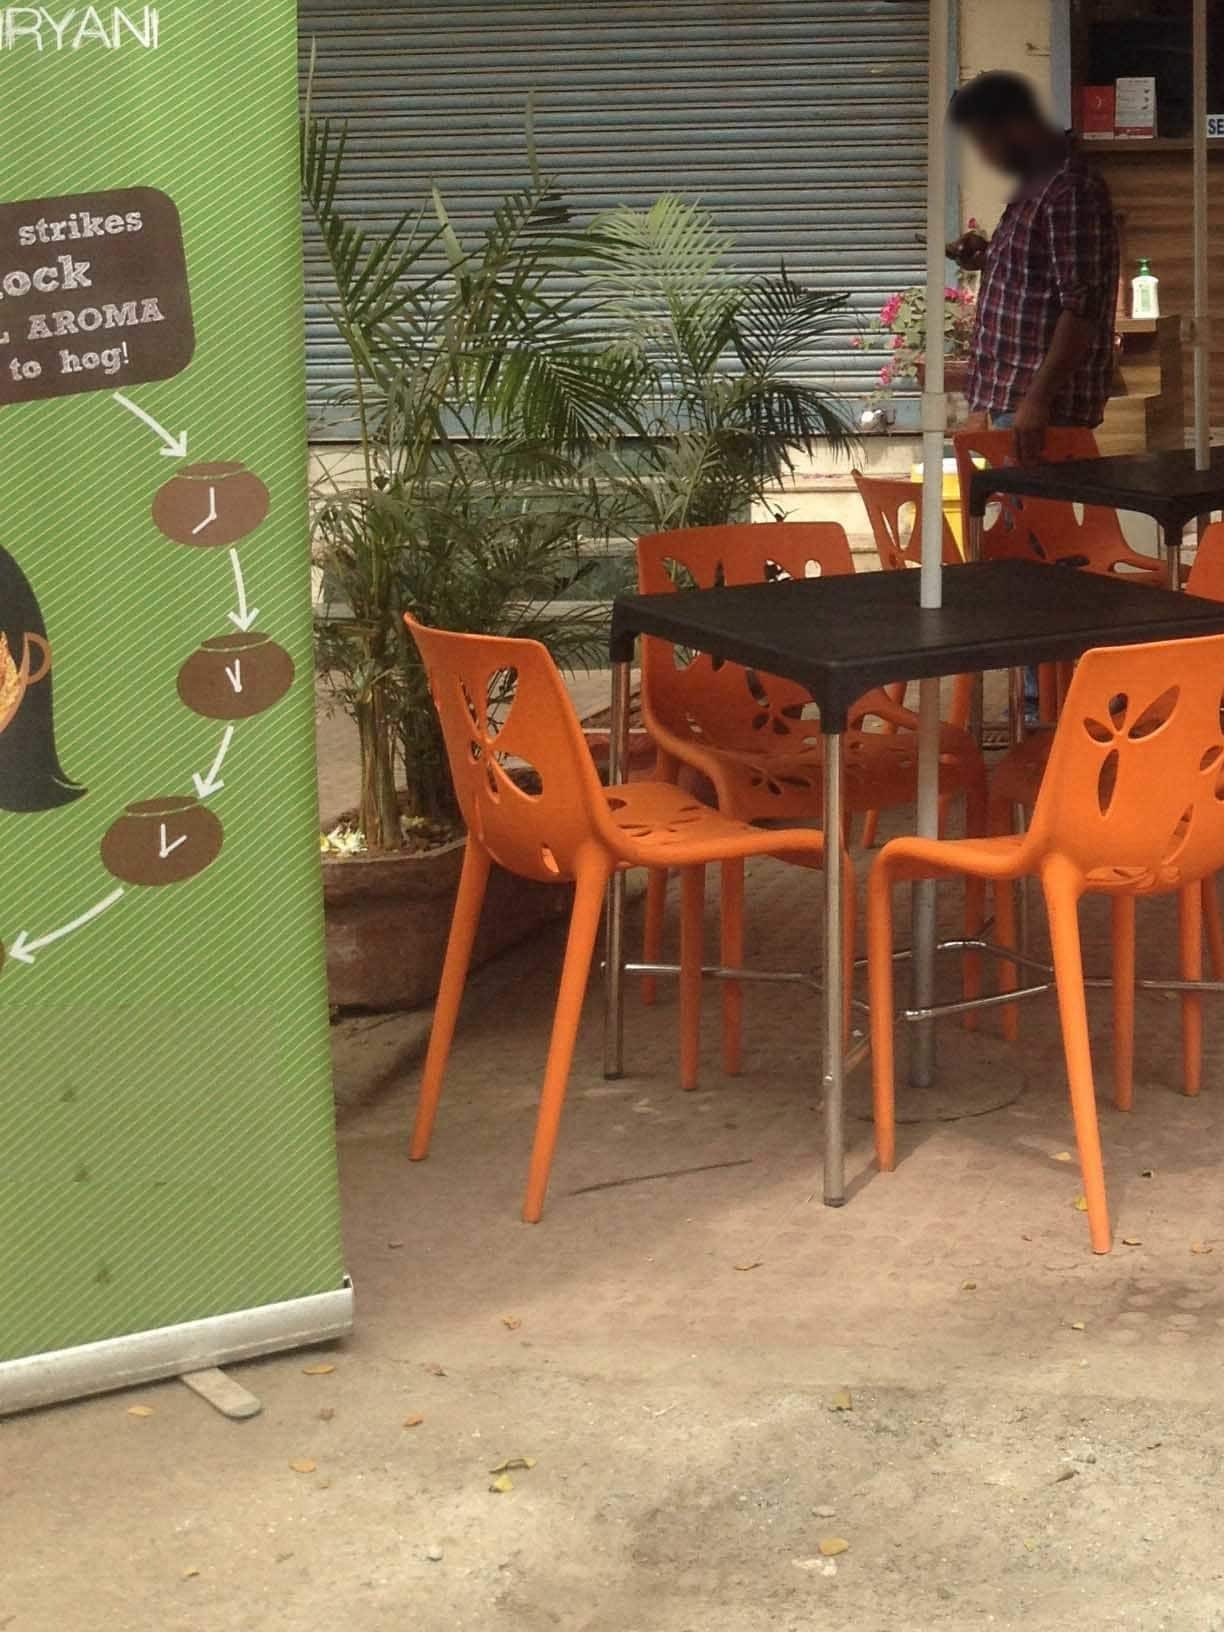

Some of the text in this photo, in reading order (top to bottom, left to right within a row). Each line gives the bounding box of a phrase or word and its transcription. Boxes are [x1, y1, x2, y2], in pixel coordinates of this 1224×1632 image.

[18, 211, 143, 246] strikes
[0, 254, 92, 299] ock
[27, 297, 165, 340] AROMA
[9, 341, 129, 381] to hog!
